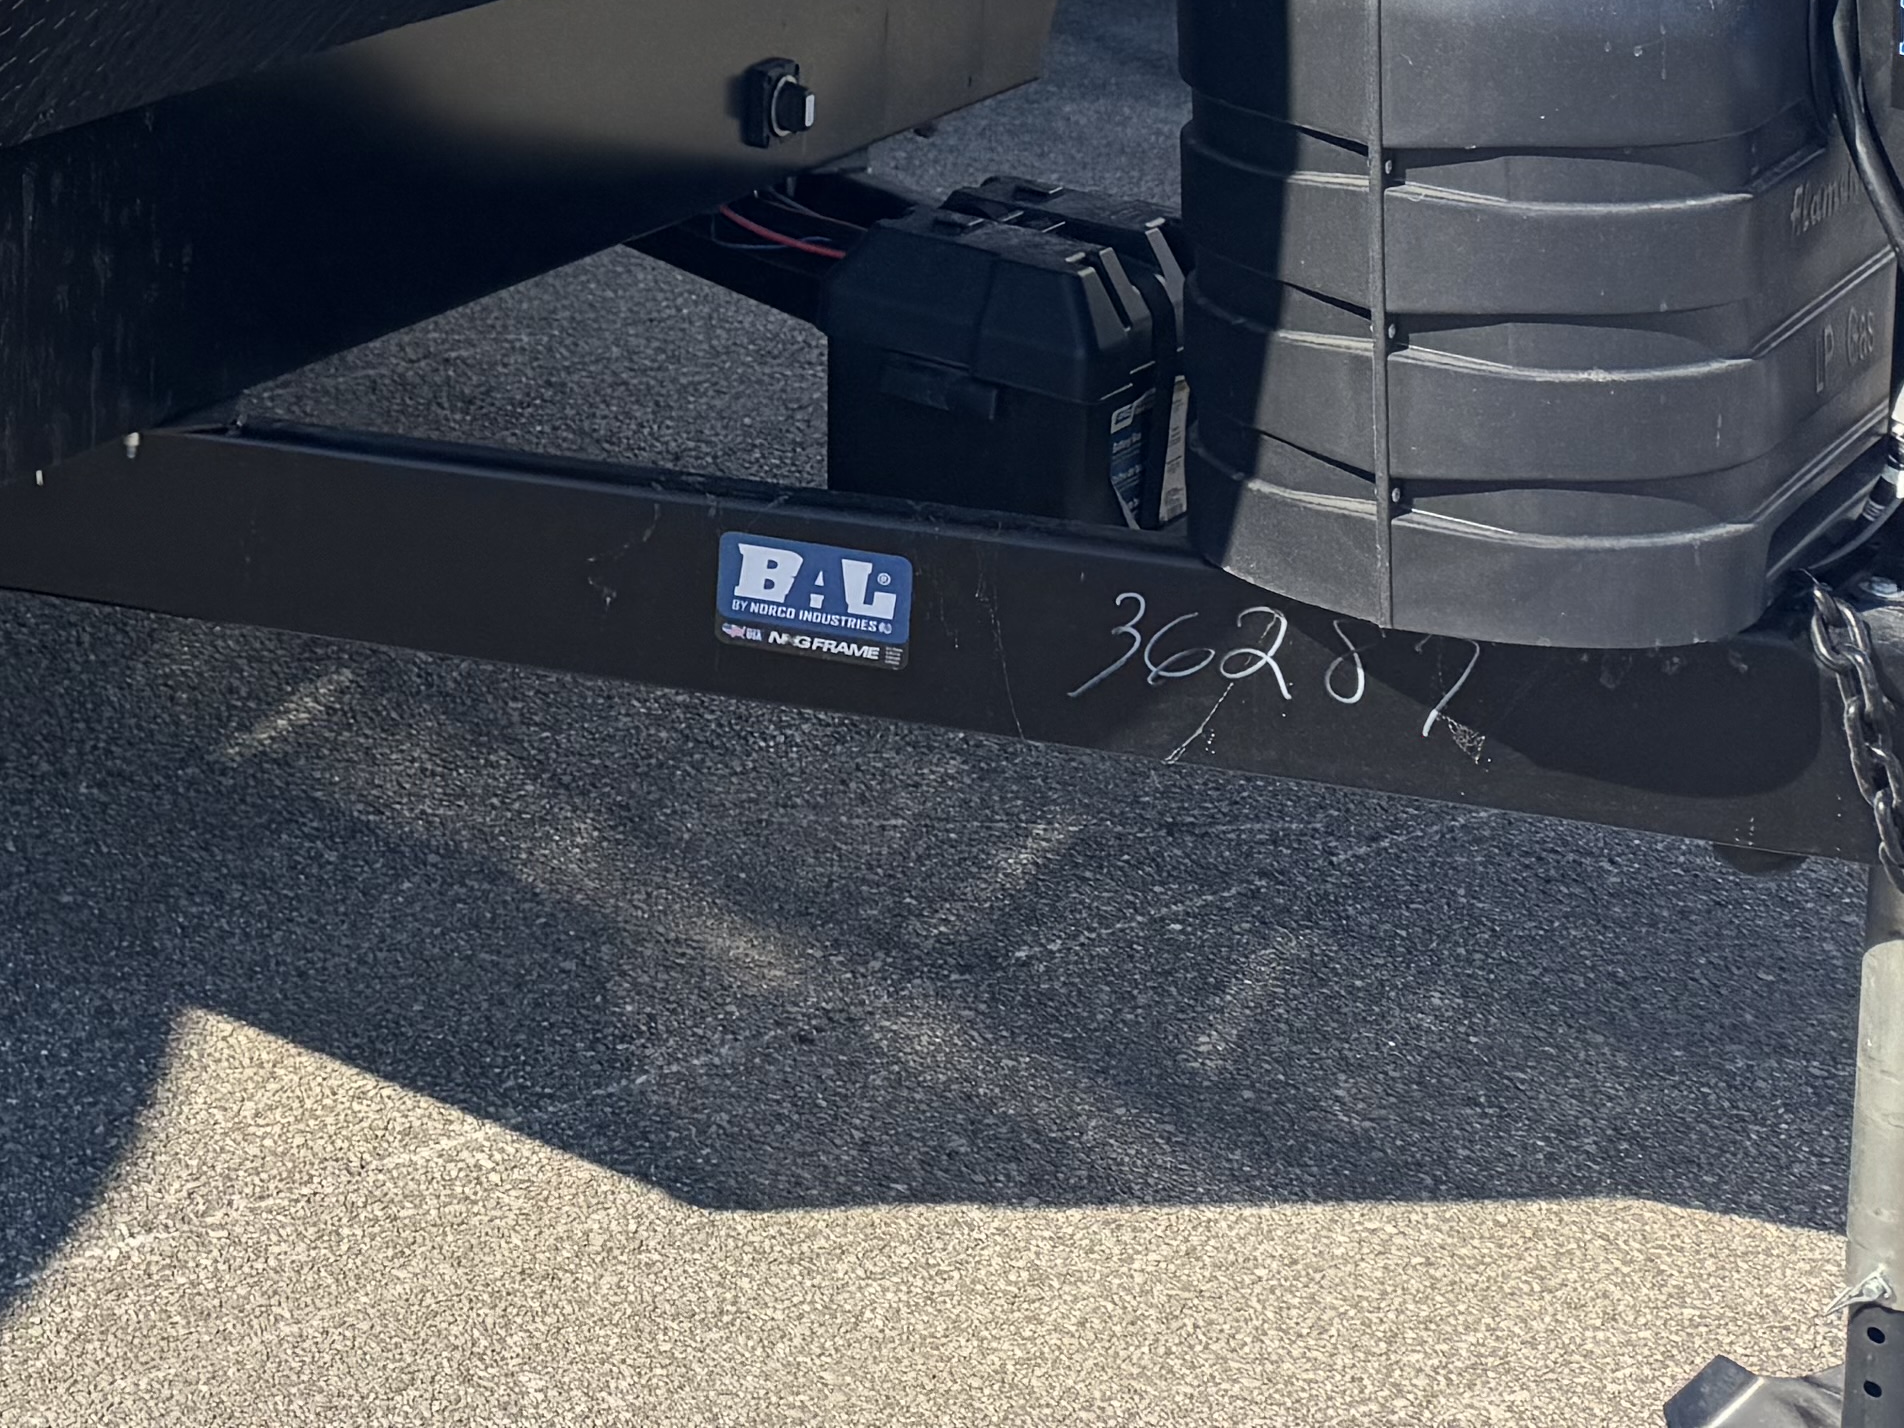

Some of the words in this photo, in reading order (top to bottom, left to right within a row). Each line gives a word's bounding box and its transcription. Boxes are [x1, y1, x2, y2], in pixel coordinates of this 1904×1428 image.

[731, 599, 748, 612] BY
[749, 602, 795, 619] NORCO
[798, 610, 877, 633] INDUSTRIES
[812, 638, 880, 660] FRAME
